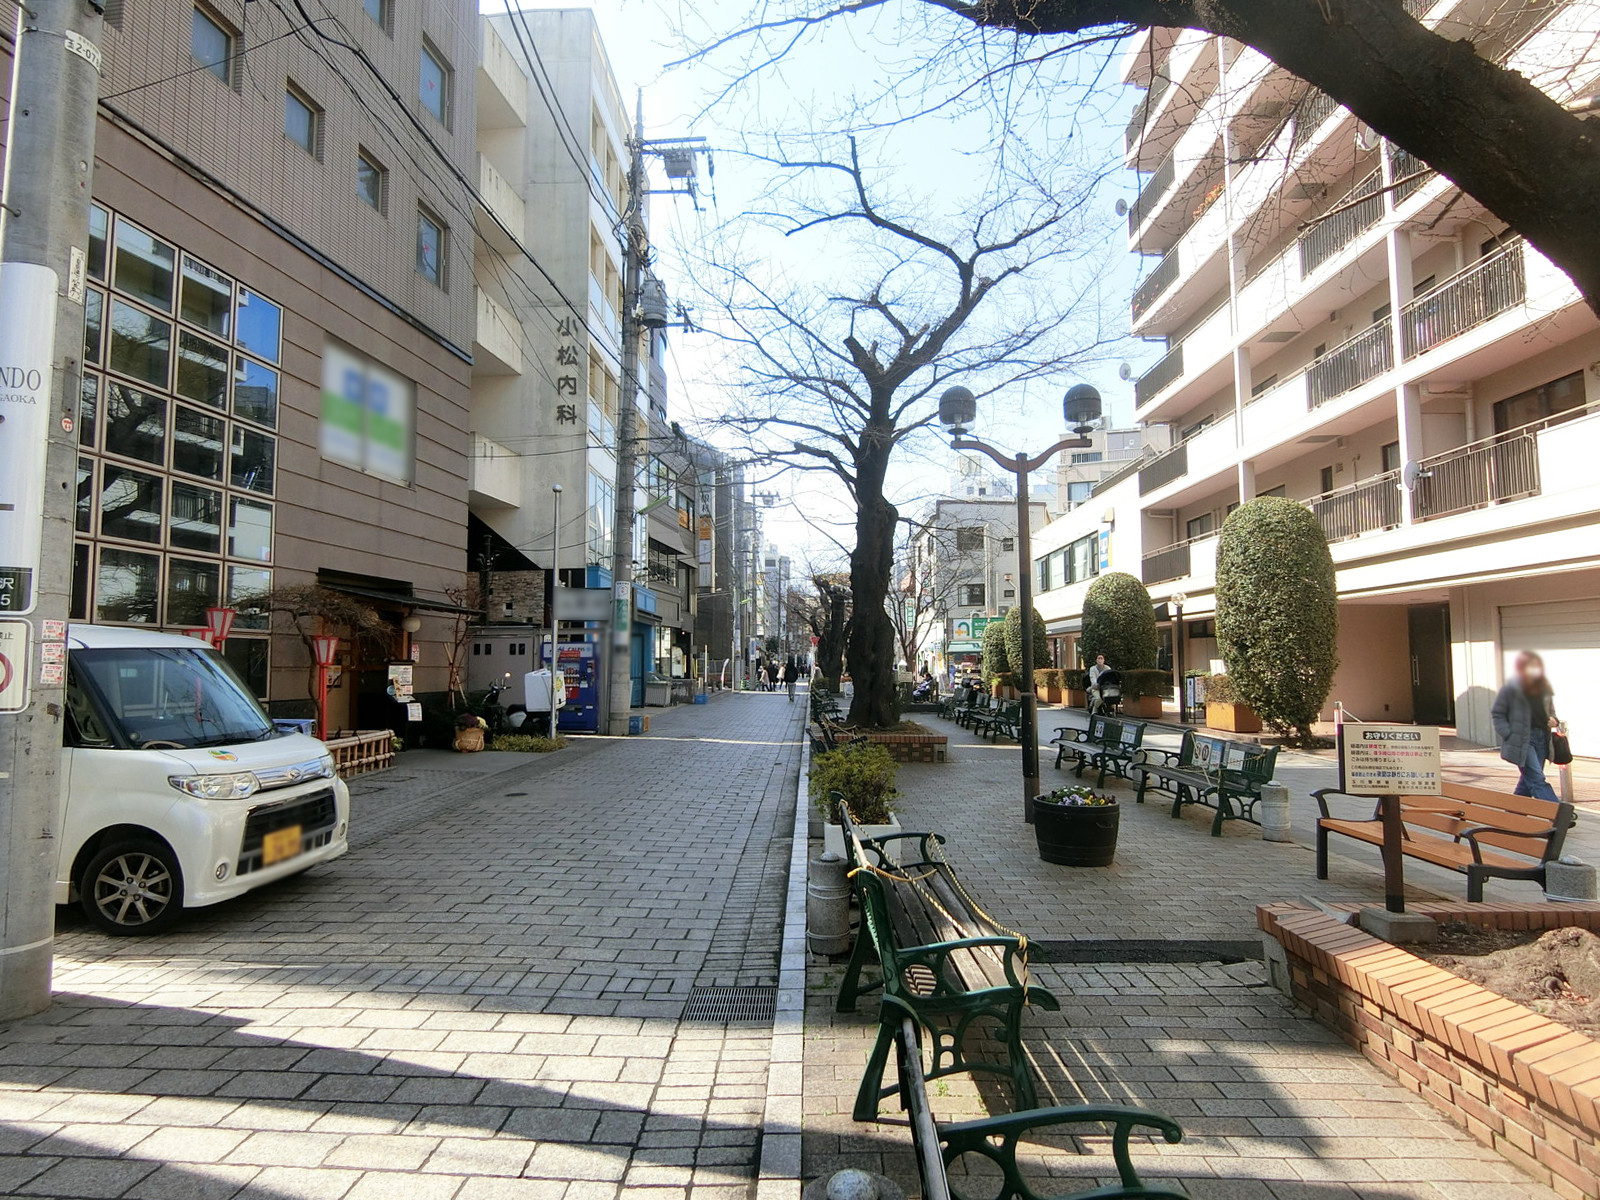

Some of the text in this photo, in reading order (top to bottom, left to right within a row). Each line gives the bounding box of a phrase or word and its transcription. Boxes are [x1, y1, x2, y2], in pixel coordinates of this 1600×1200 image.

[557, 316, 578, 425] 小松内科
[1365, 732, 1418, 740] お守りください
